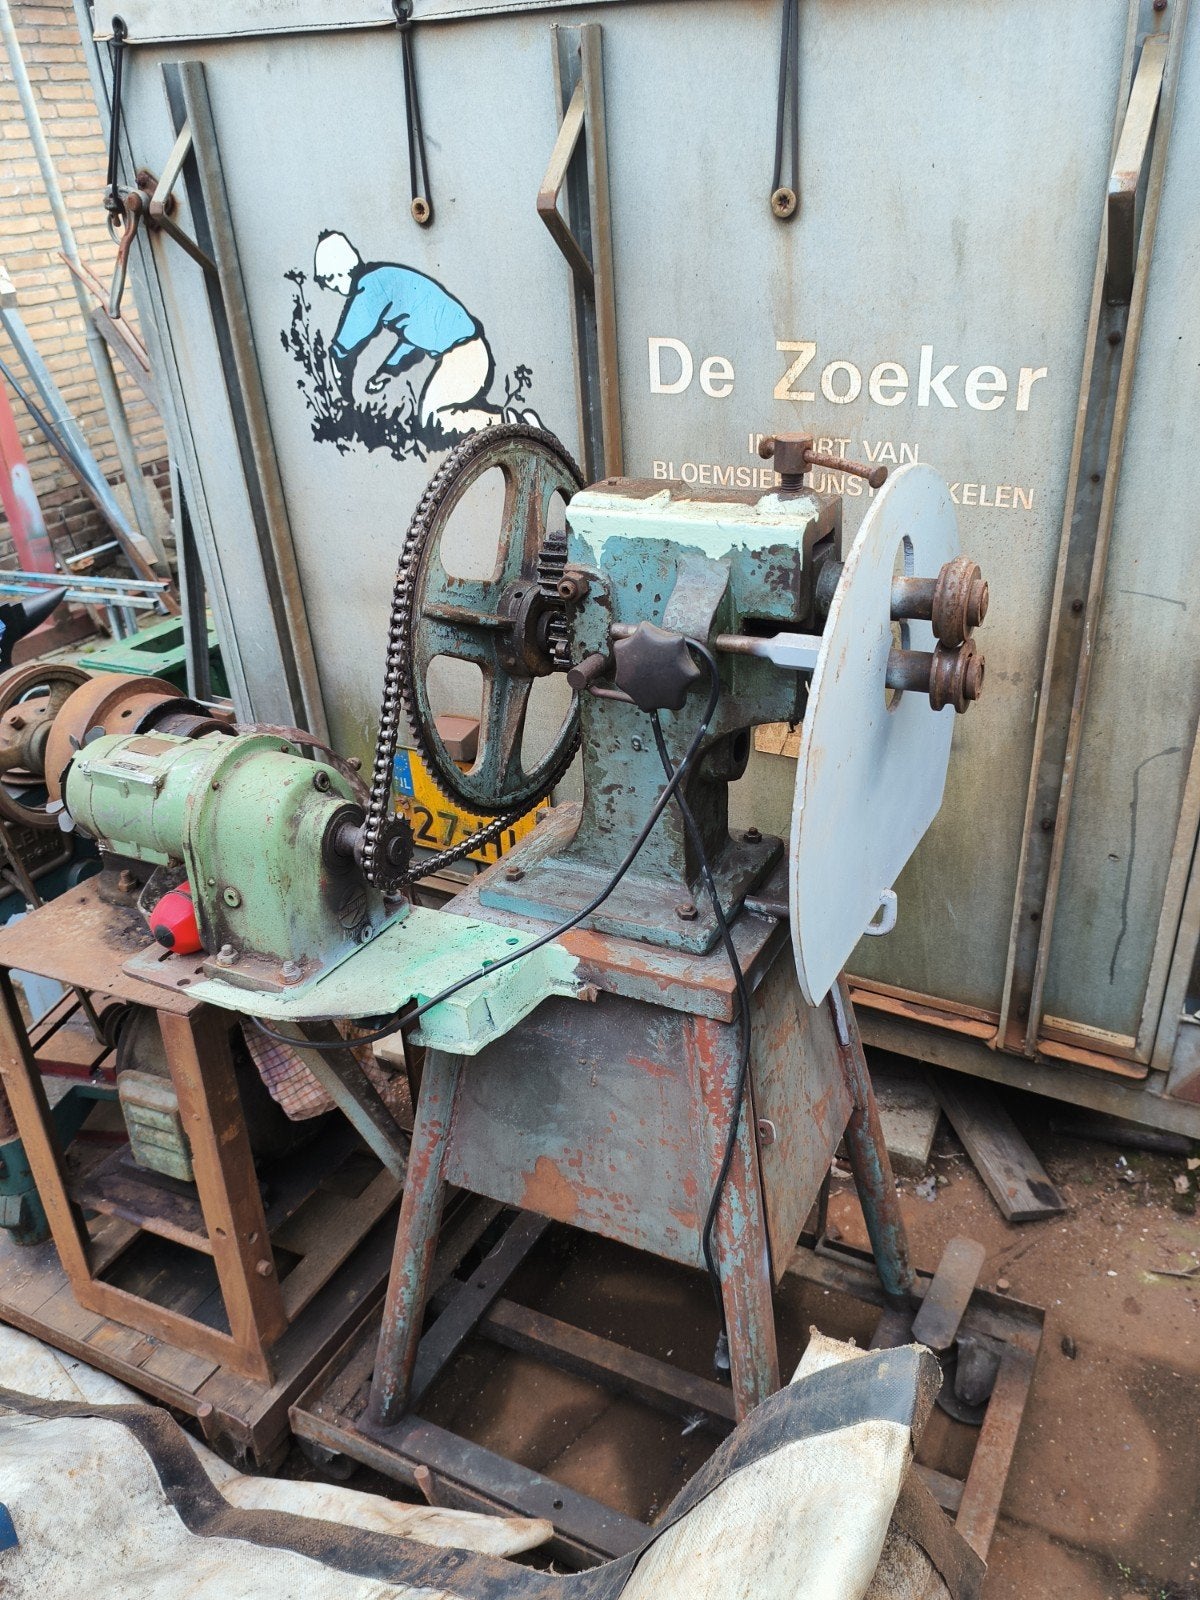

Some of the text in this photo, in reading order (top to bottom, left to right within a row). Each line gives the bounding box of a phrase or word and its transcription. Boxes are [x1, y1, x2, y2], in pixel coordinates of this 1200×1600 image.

[647, 336, 1047, 412] De Zoeker
[862, 439, 919, 464] VAN
